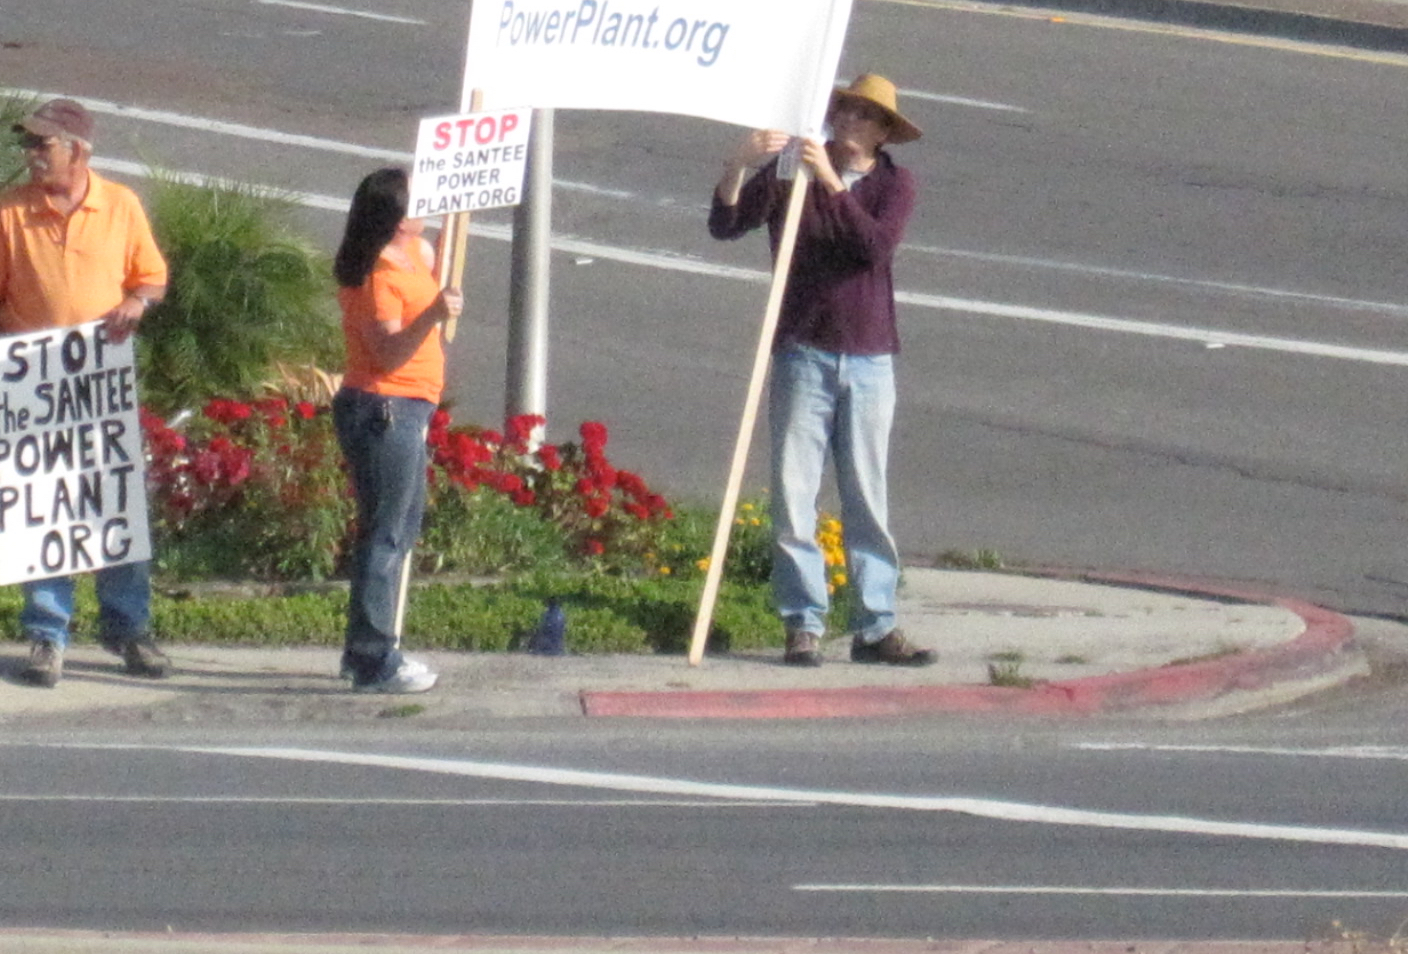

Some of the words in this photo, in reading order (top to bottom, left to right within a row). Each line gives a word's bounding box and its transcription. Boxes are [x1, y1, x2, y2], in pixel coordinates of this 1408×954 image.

[433, 114, 518, 151] STOP
[419, 157, 446, 173] the
[453, 144, 525, 169] SANTEE
[437, 168, 500, 191] POWER
[415, 186, 516, 216] PLANT.ORG
[34, 366, 133, 425] SANTEE
[27, 517, 132, 574] .ORG
